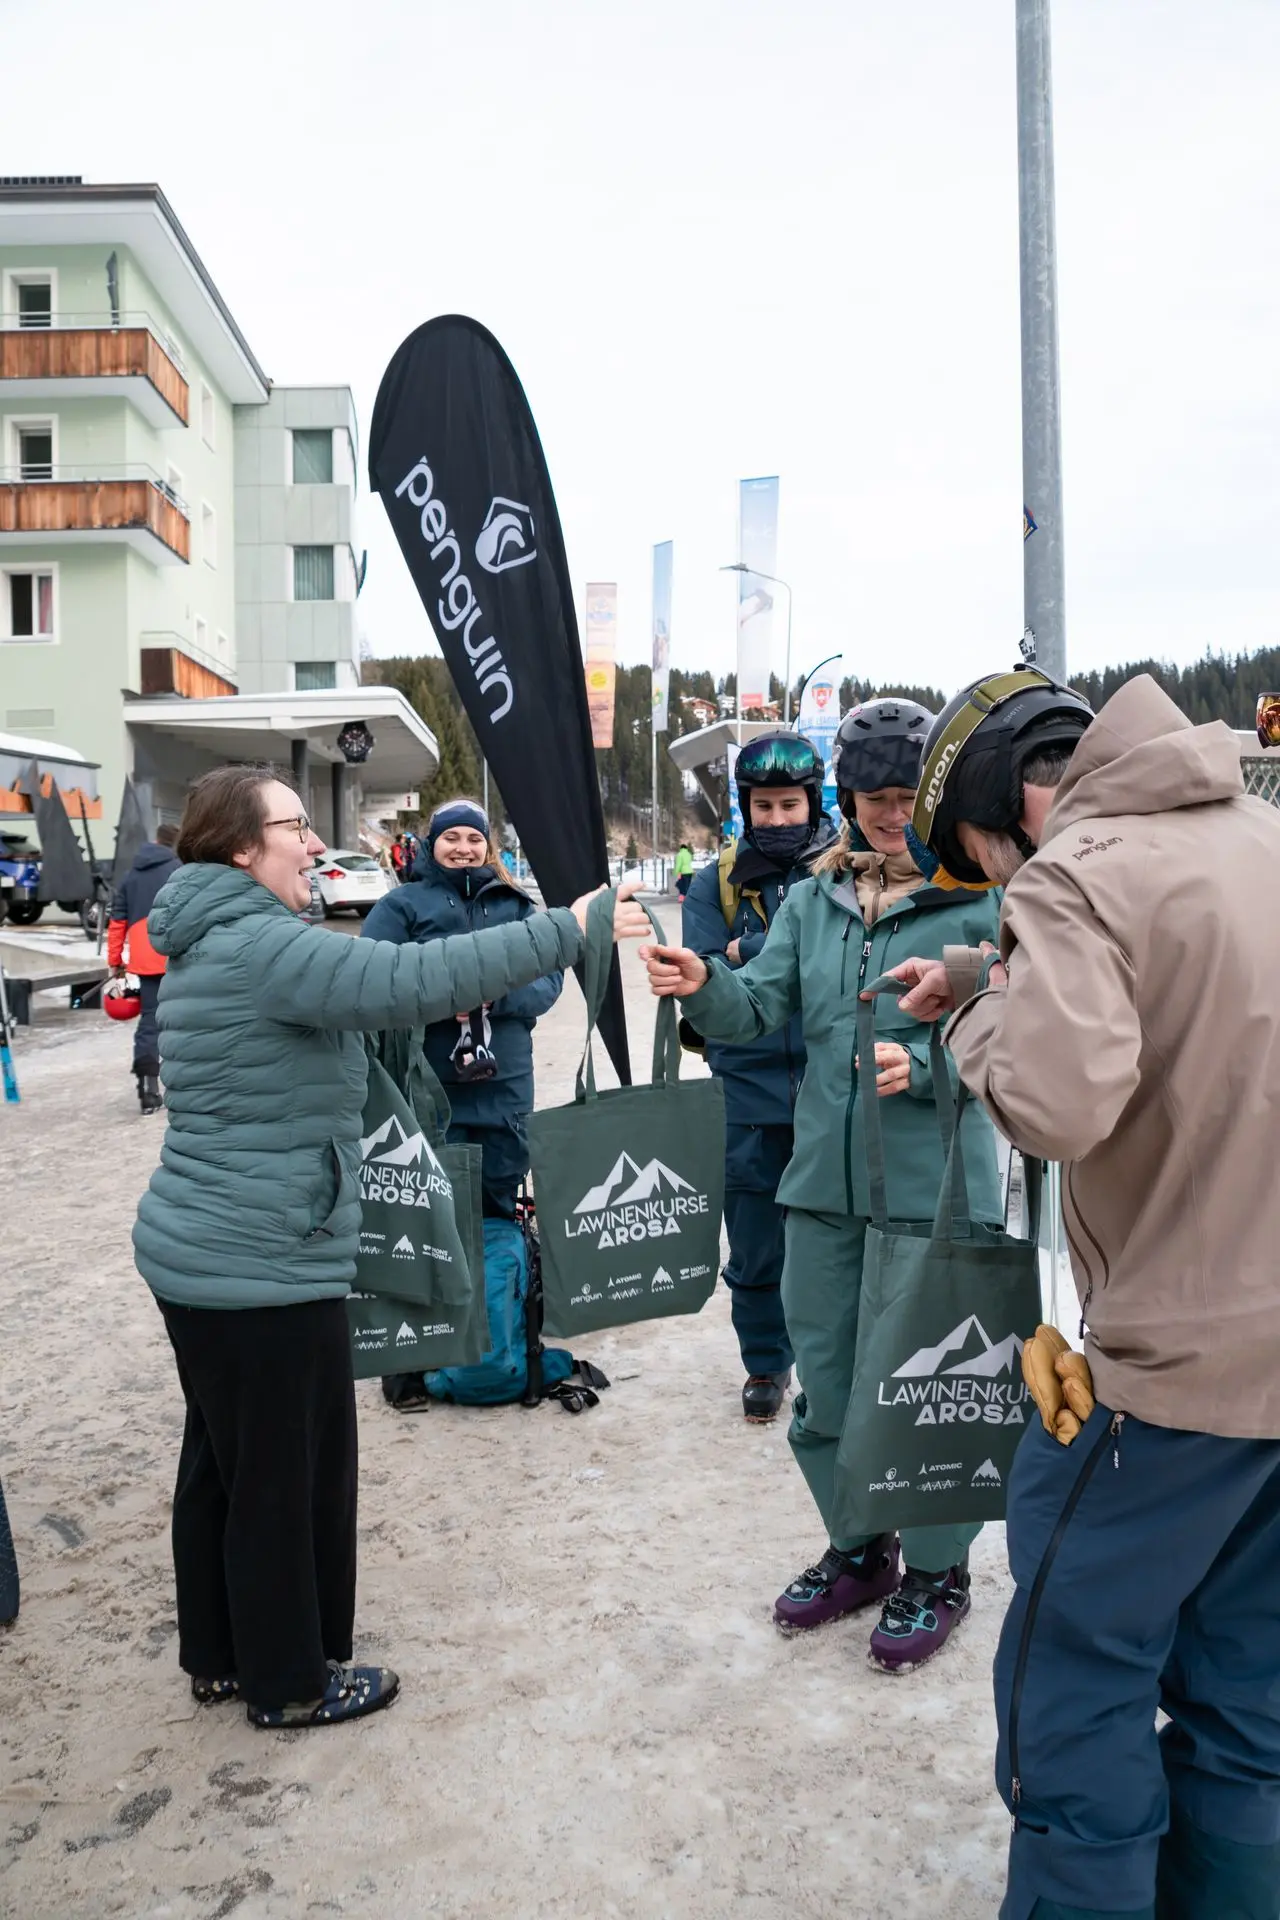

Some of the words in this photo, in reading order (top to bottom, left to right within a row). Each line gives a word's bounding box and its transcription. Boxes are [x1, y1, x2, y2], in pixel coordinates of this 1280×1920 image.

[395, 455, 514, 724] penguin
[924, 739, 960, 813] anon.
[564, 1194, 710, 1238] LAWINENKURSE
[360, 1232, 386, 1240] ATOMIC
[597, 1216, 682, 1250] AROSA
[615, 1272, 642, 1284] ATOMIC
[570, 1291, 603, 1305] penguin
[361, 1327, 388, 1335] ATOMIC
[914, 1401, 1025, 1426] AROSA
[928, 1462, 963, 1472] ATOMIC
[869, 1480, 910, 1493] penguin
